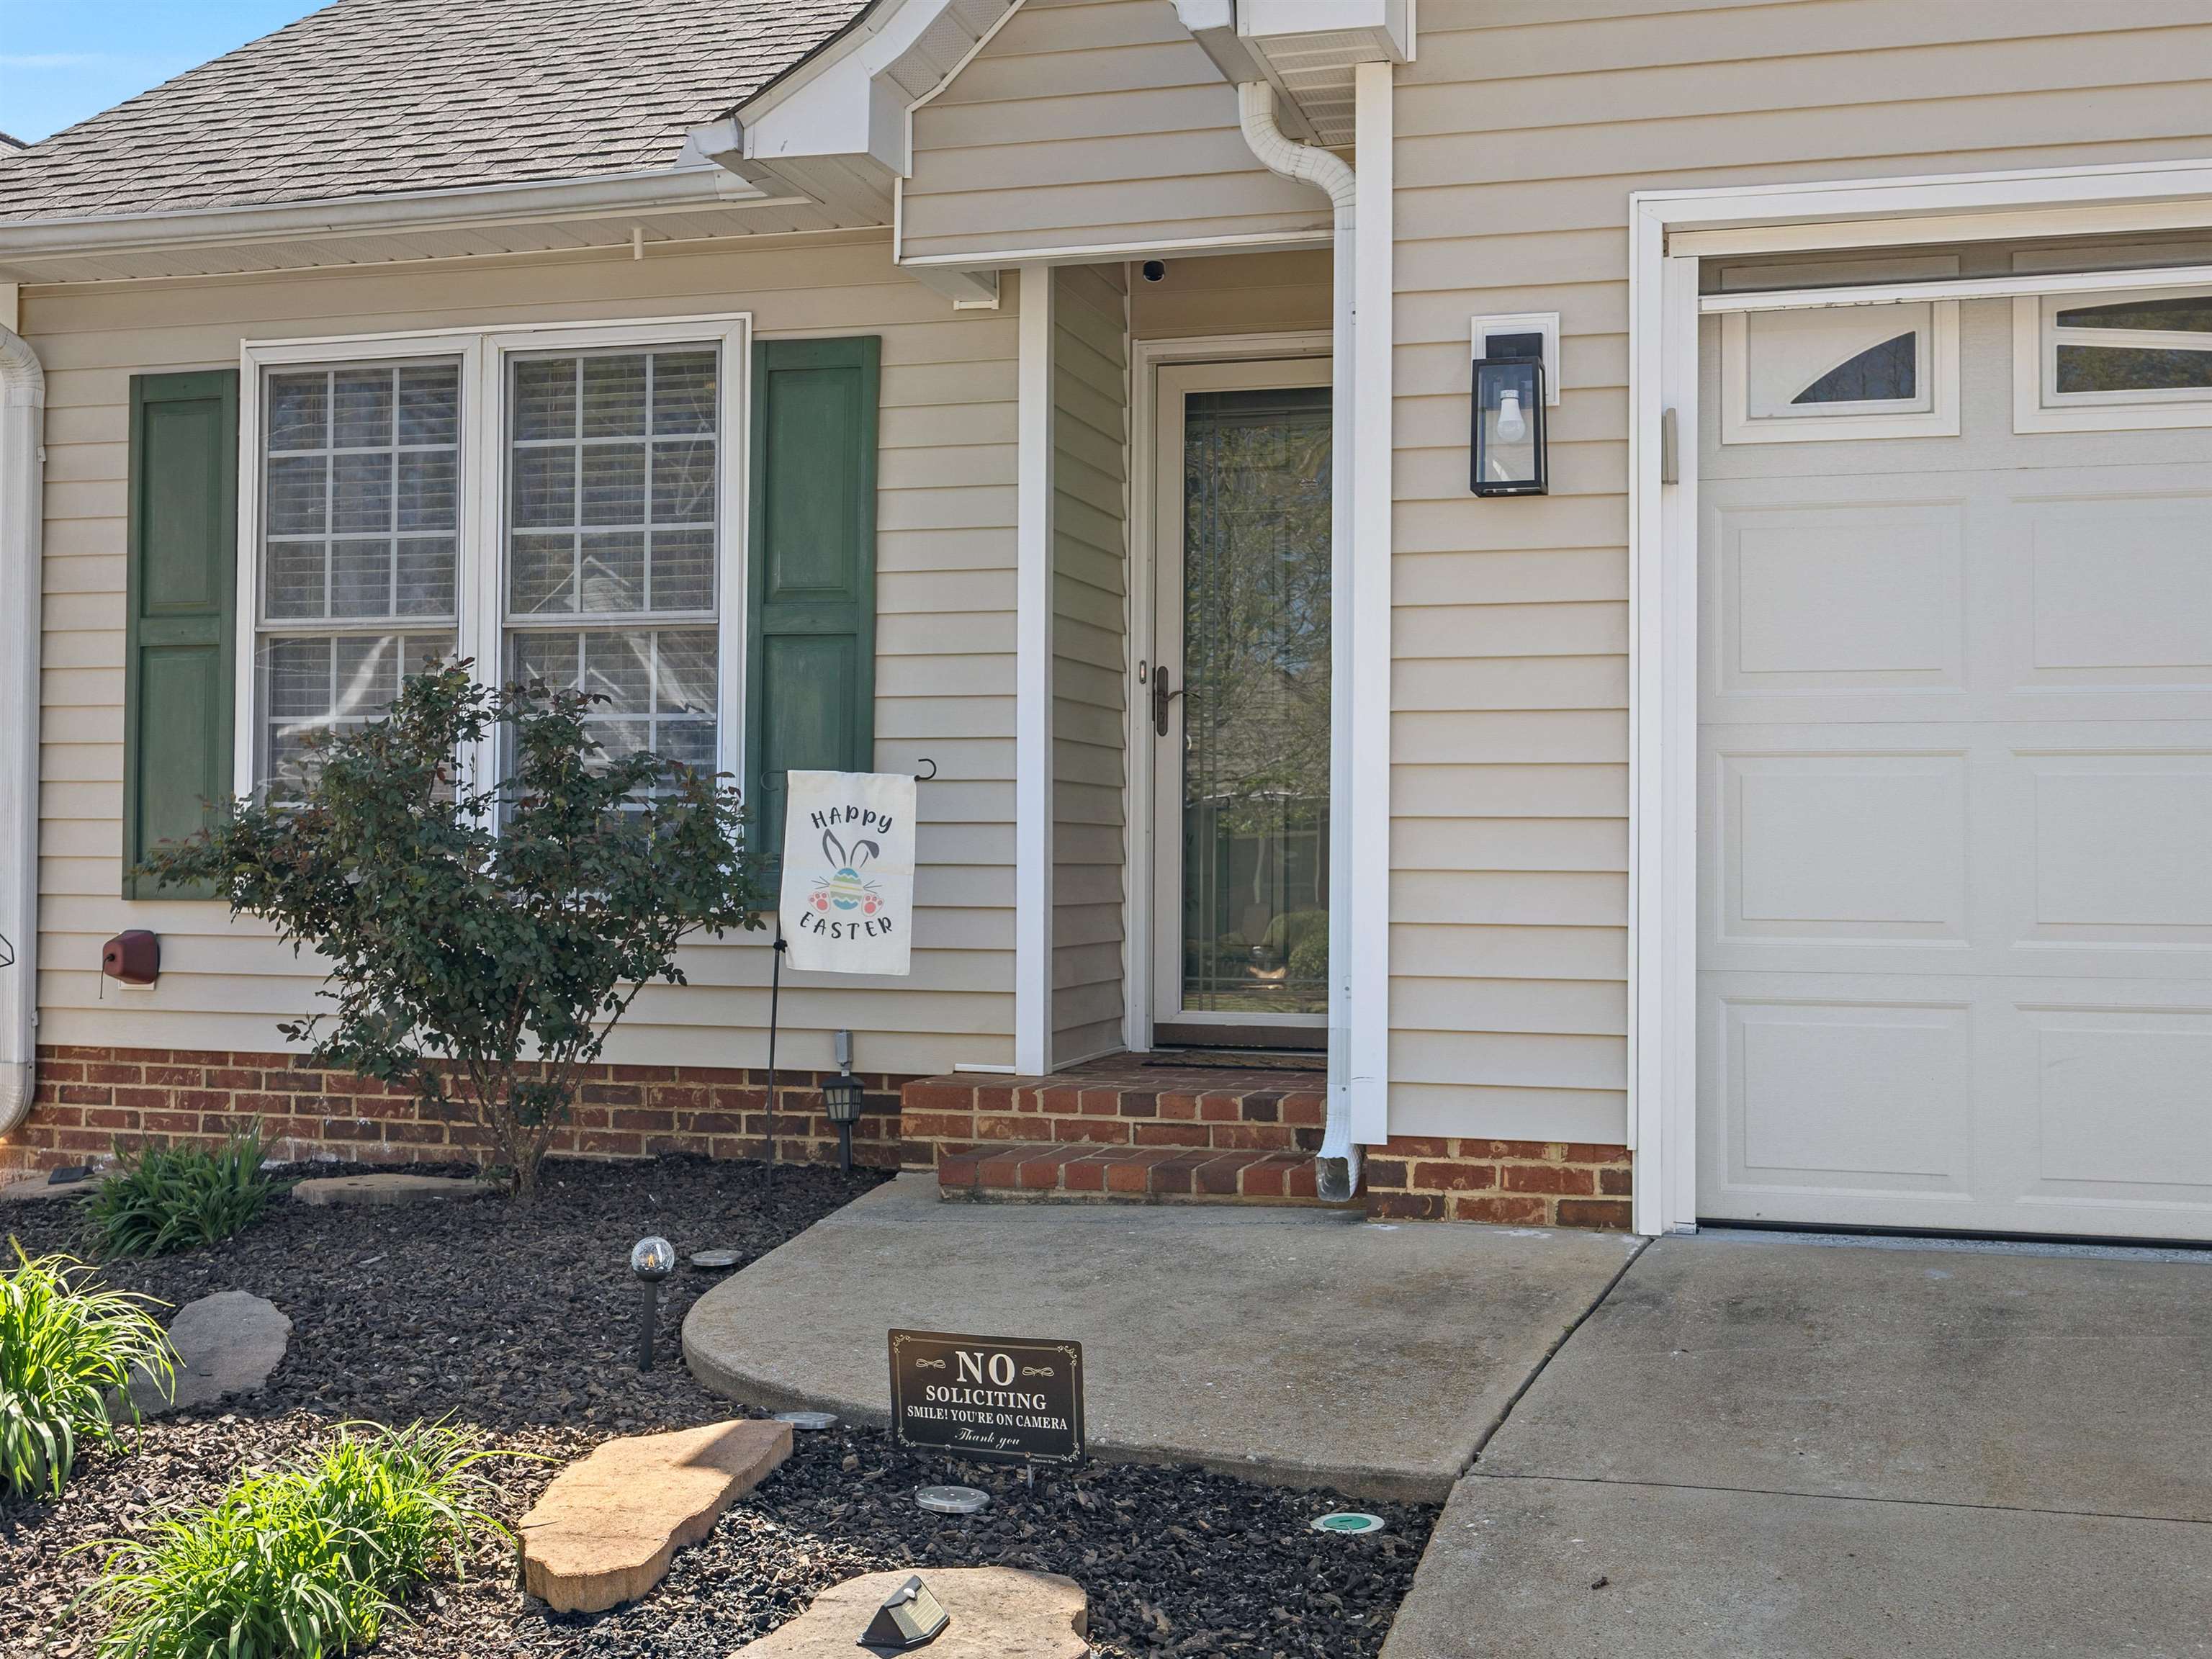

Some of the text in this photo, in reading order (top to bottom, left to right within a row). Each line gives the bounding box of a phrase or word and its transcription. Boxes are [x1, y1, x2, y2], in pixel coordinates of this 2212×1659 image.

[800, 912, 893, 940] EASTER
[955, 1351, 1015, 1386] NO
[926, 1385, 1047, 1410] SOLICITING
[907, 1405, 1068, 1430] SMILE! YOU'RE ON CAMERA
[955, 1427, 1020, 1449] Thank you
